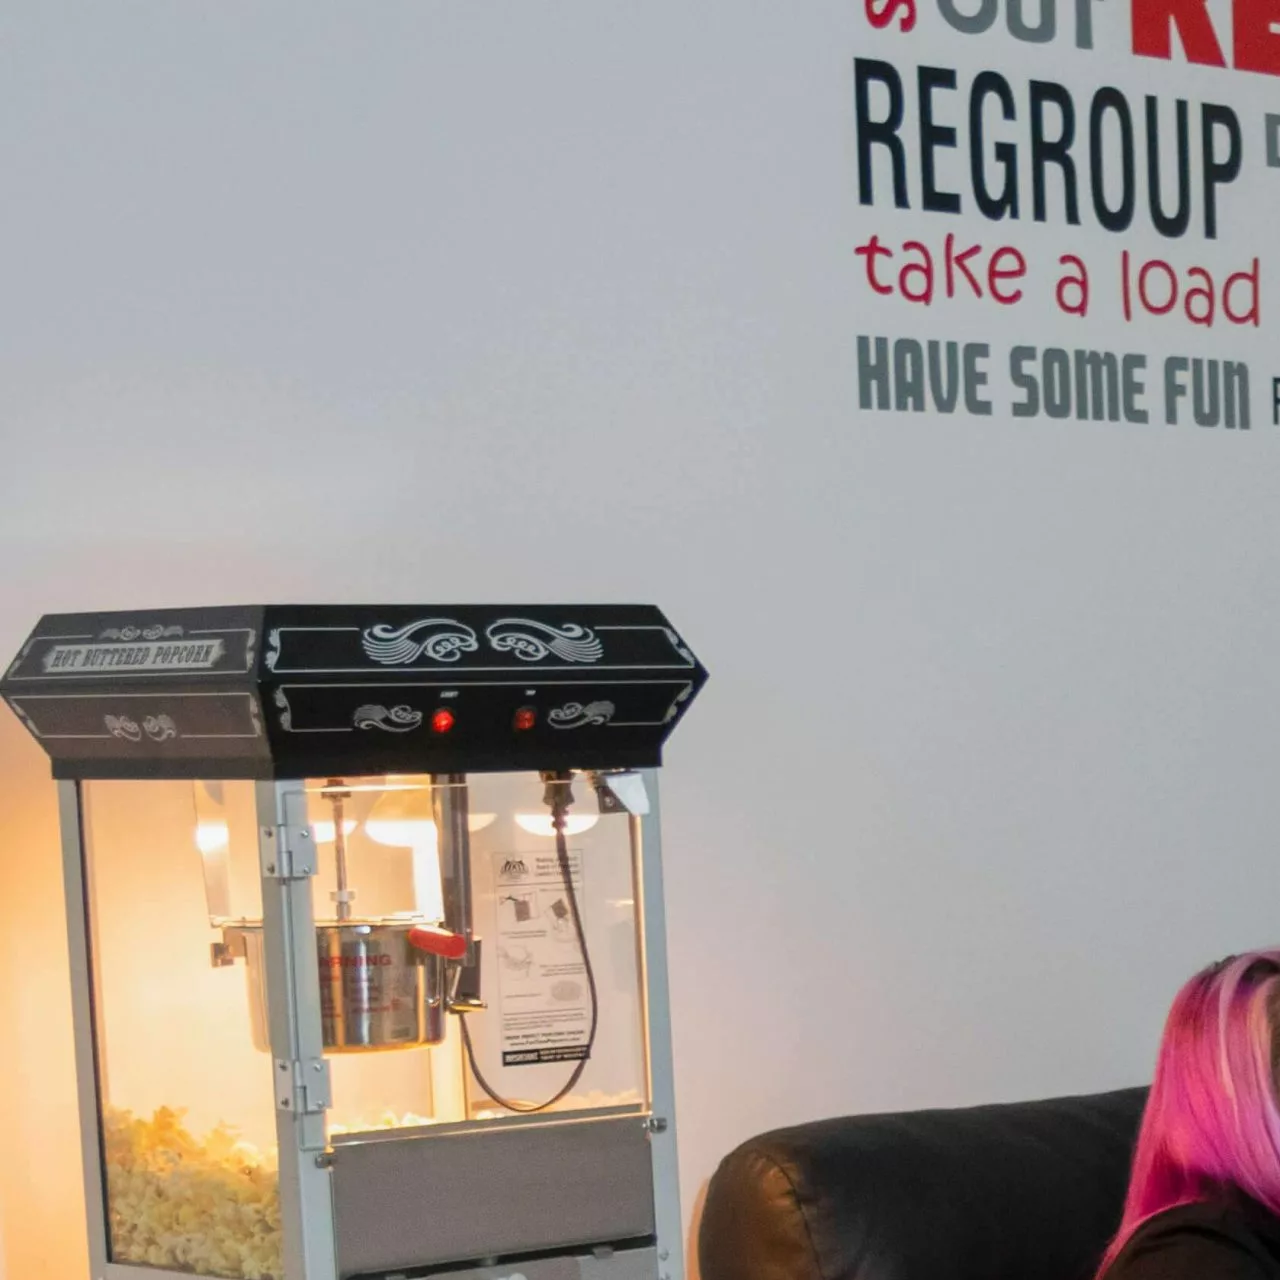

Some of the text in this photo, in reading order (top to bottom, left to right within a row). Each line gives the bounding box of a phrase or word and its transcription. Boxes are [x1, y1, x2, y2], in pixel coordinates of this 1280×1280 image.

[854, 57, 1242, 240] REGROUP
[854, 232, 1028, 306] take
[1056, 253, 1088, 318] a
[1122, 249, 1260, 328] load
[857, 335, 1251, 430] HAVE SOME FUN
[51, 644, 215, 667] HOT BUTTERED POPCORN
